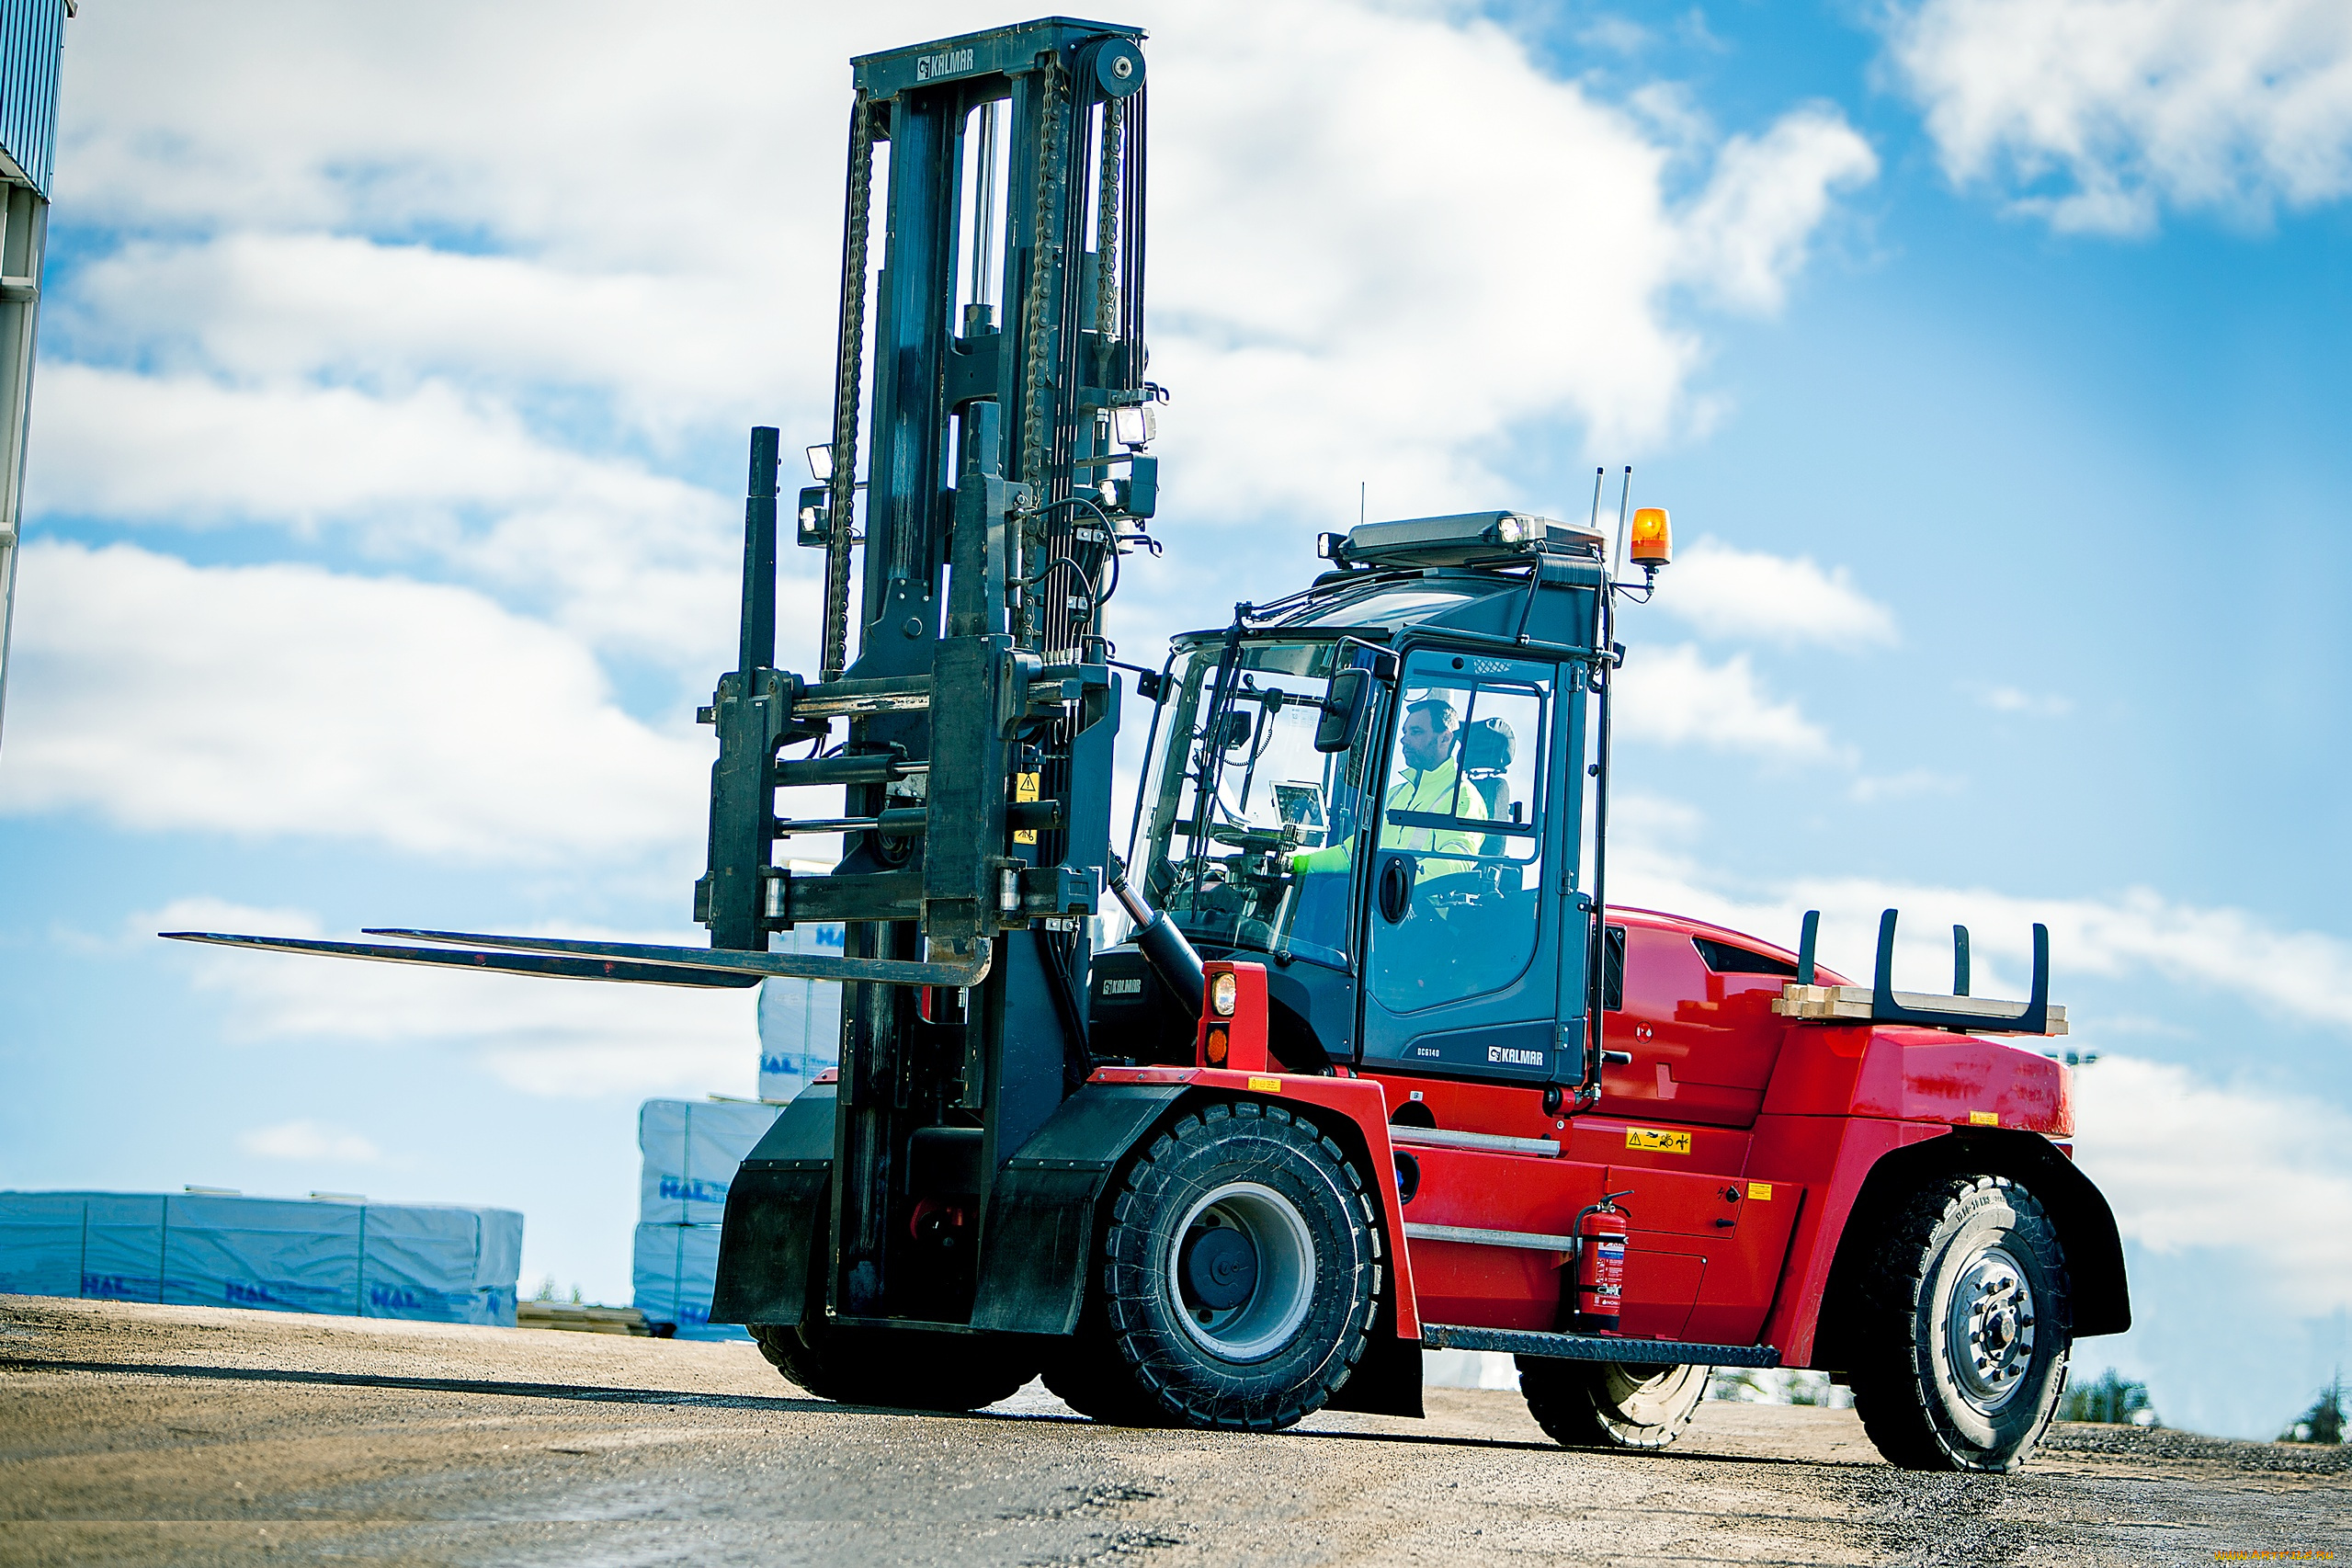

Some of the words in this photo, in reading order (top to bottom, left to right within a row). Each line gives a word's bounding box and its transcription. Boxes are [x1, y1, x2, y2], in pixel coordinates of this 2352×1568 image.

[931, 49, 973, 77] KALMAR
[816, 926, 845, 948] HA
[1501, 1048, 1543, 1066] KALMAR
